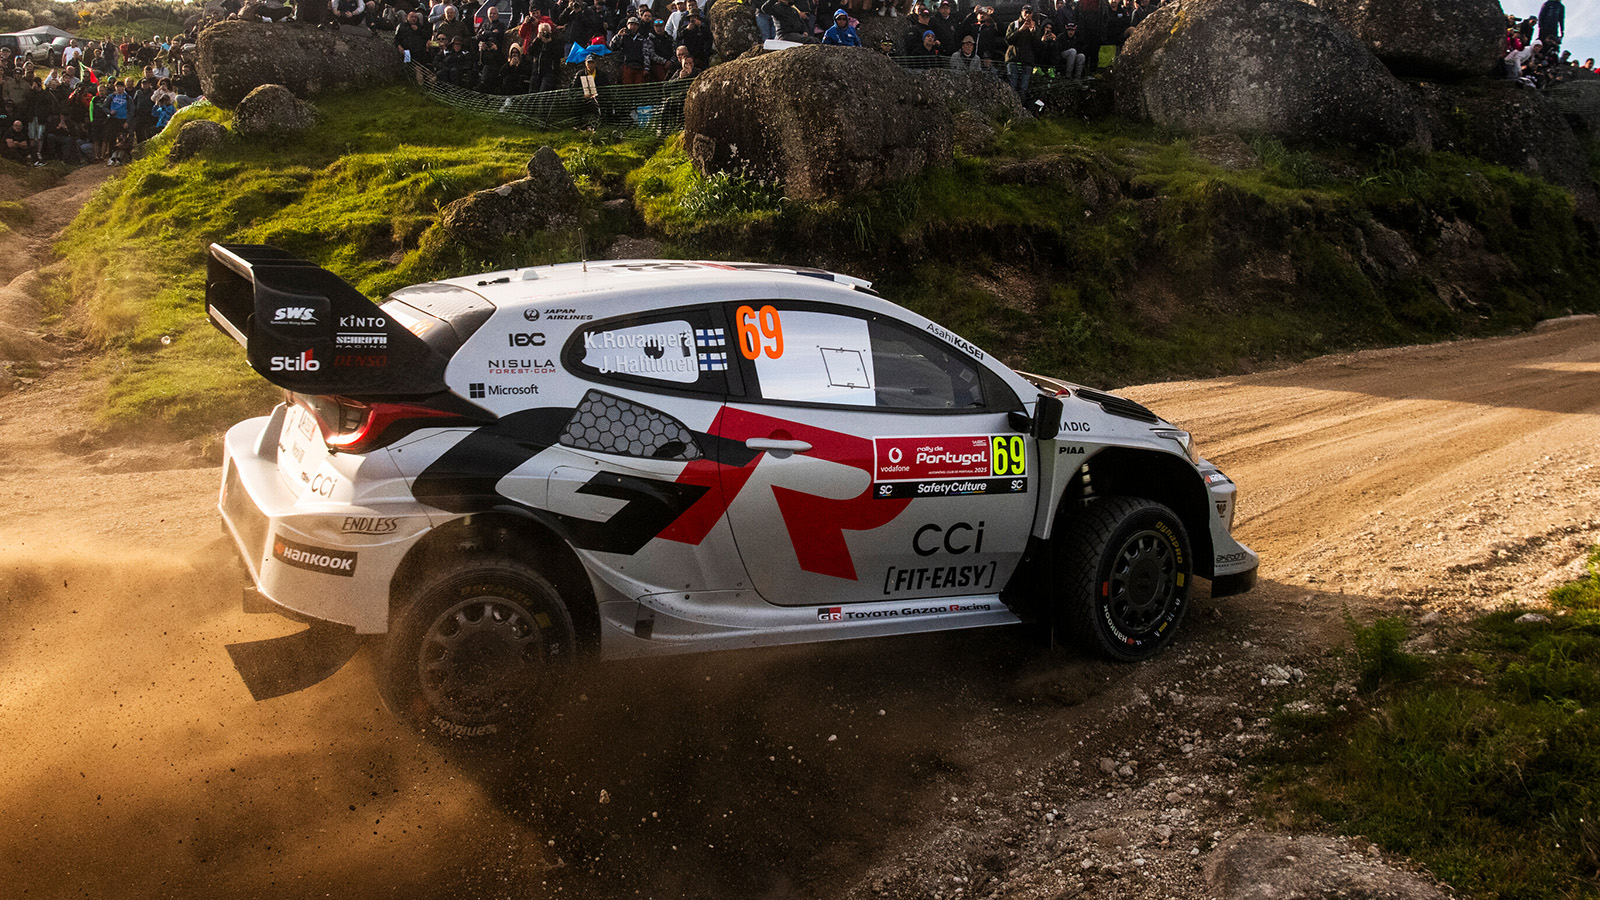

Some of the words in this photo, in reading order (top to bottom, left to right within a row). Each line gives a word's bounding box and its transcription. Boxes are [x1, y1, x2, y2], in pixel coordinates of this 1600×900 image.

[274, 307, 316, 321] SWS
[736, 305, 784, 360] 69
[336, 336, 387, 344] SCHROTH
[270, 348, 320, 371] Stilo
[334, 355, 388, 367] DENSO
[488, 359, 555, 368] NISULA
[488, 383, 539, 395] Microsoft
[992, 436, 1025, 475] 69
[1058, 446, 1085, 455] PIAA
[916, 451, 988, 466] Portugal
[880, 464, 910, 473] vodafone
[879, 485, 893, 495] SC
[1011, 479, 1024, 490] SC
[342, 516, 399, 531] ENDLESS
[912, 521, 985, 557] CCi
[818, 612, 842, 622] GR
[845, 610, 899, 619] TOYOTA
[901, 606, 947, 615] GAZOO
[949, 603, 991, 612] Racing
